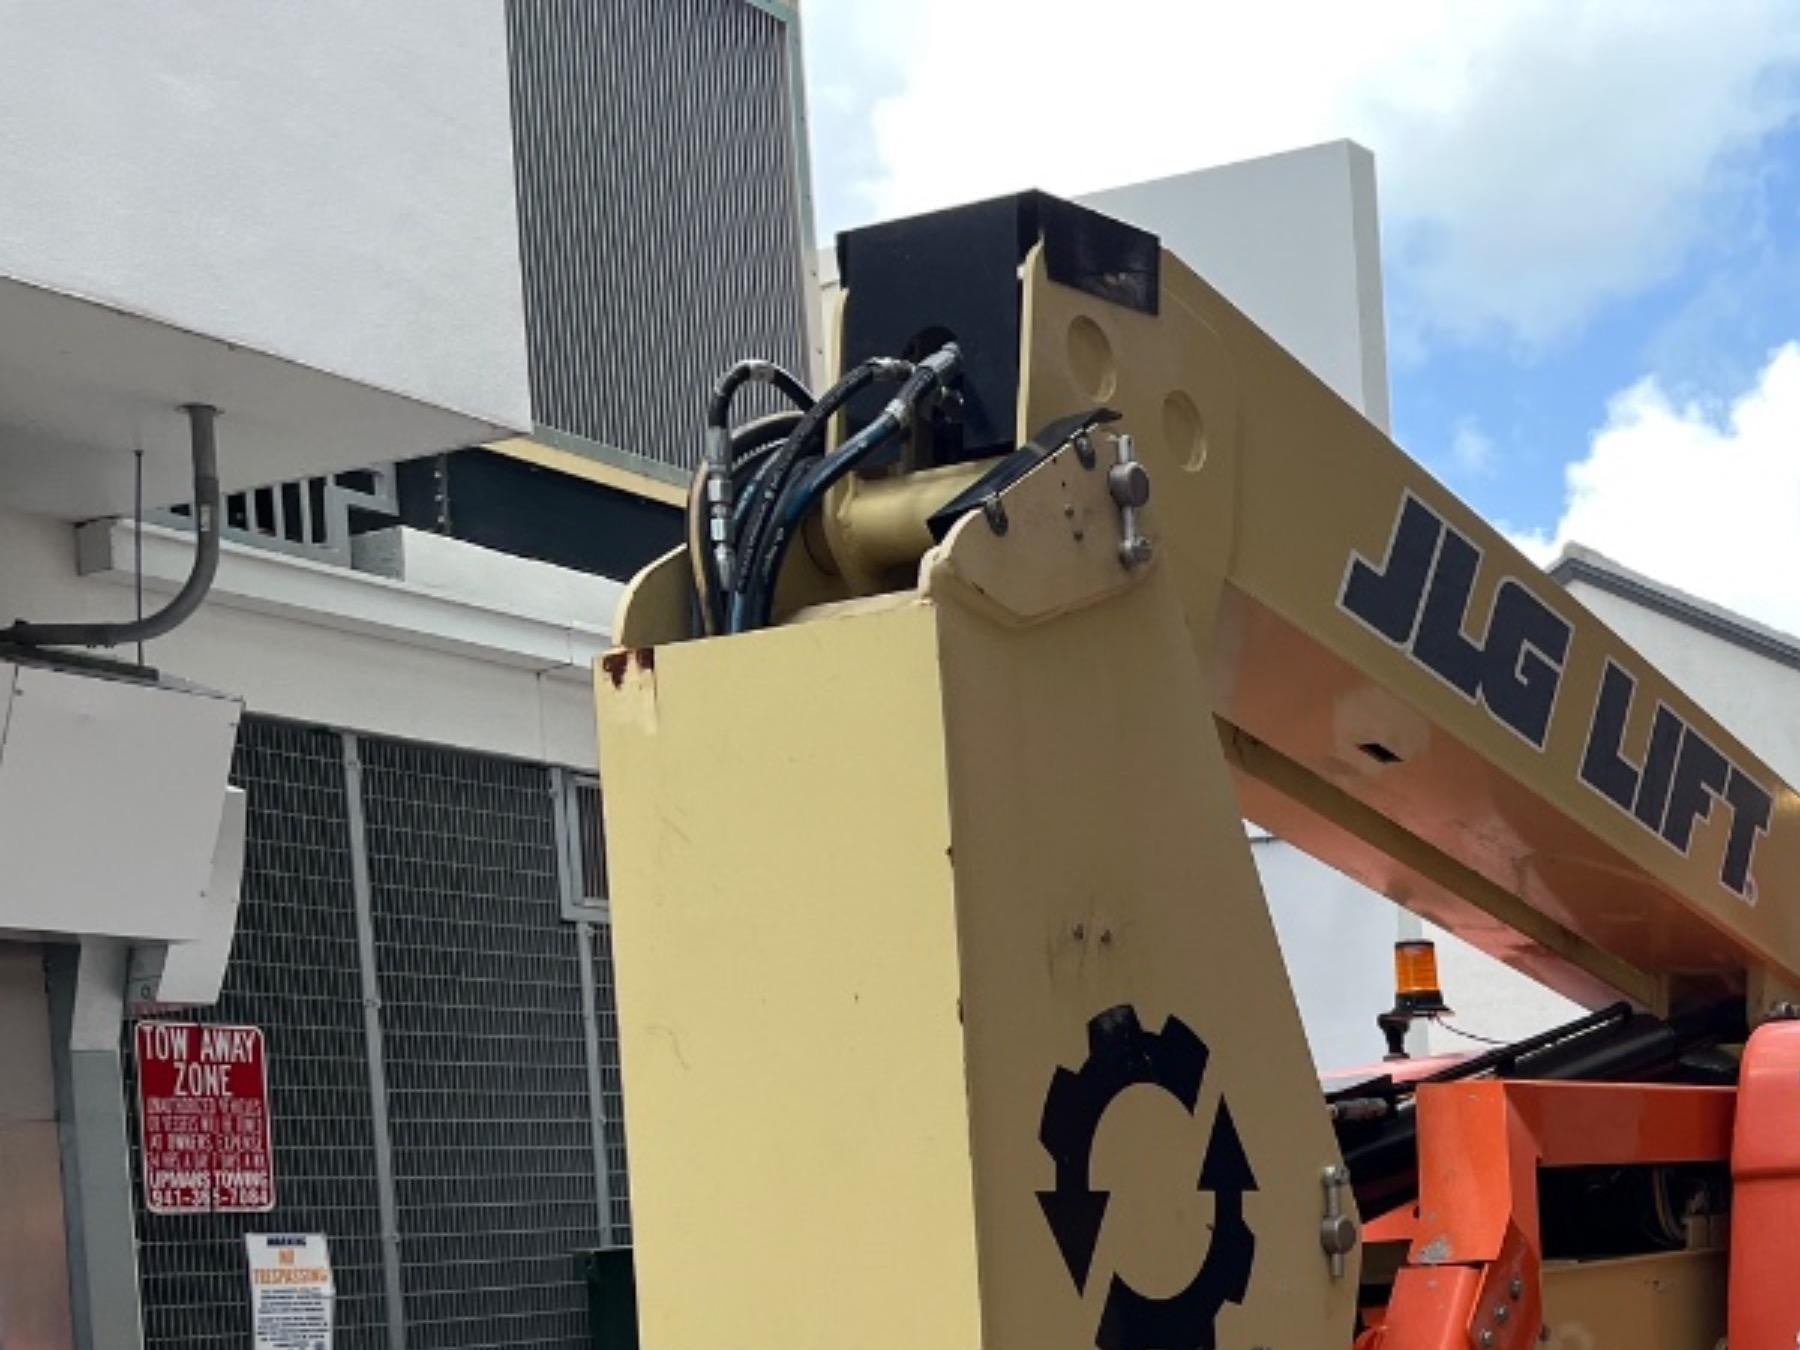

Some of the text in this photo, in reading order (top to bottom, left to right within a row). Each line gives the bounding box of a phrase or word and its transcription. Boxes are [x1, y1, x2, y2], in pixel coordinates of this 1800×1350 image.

[1336, 488, 1775, 901] JLG LIFT
[142, 1026, 256, 1063] TOW AWAY
[174, 1062, 233, 1096] ZONE
